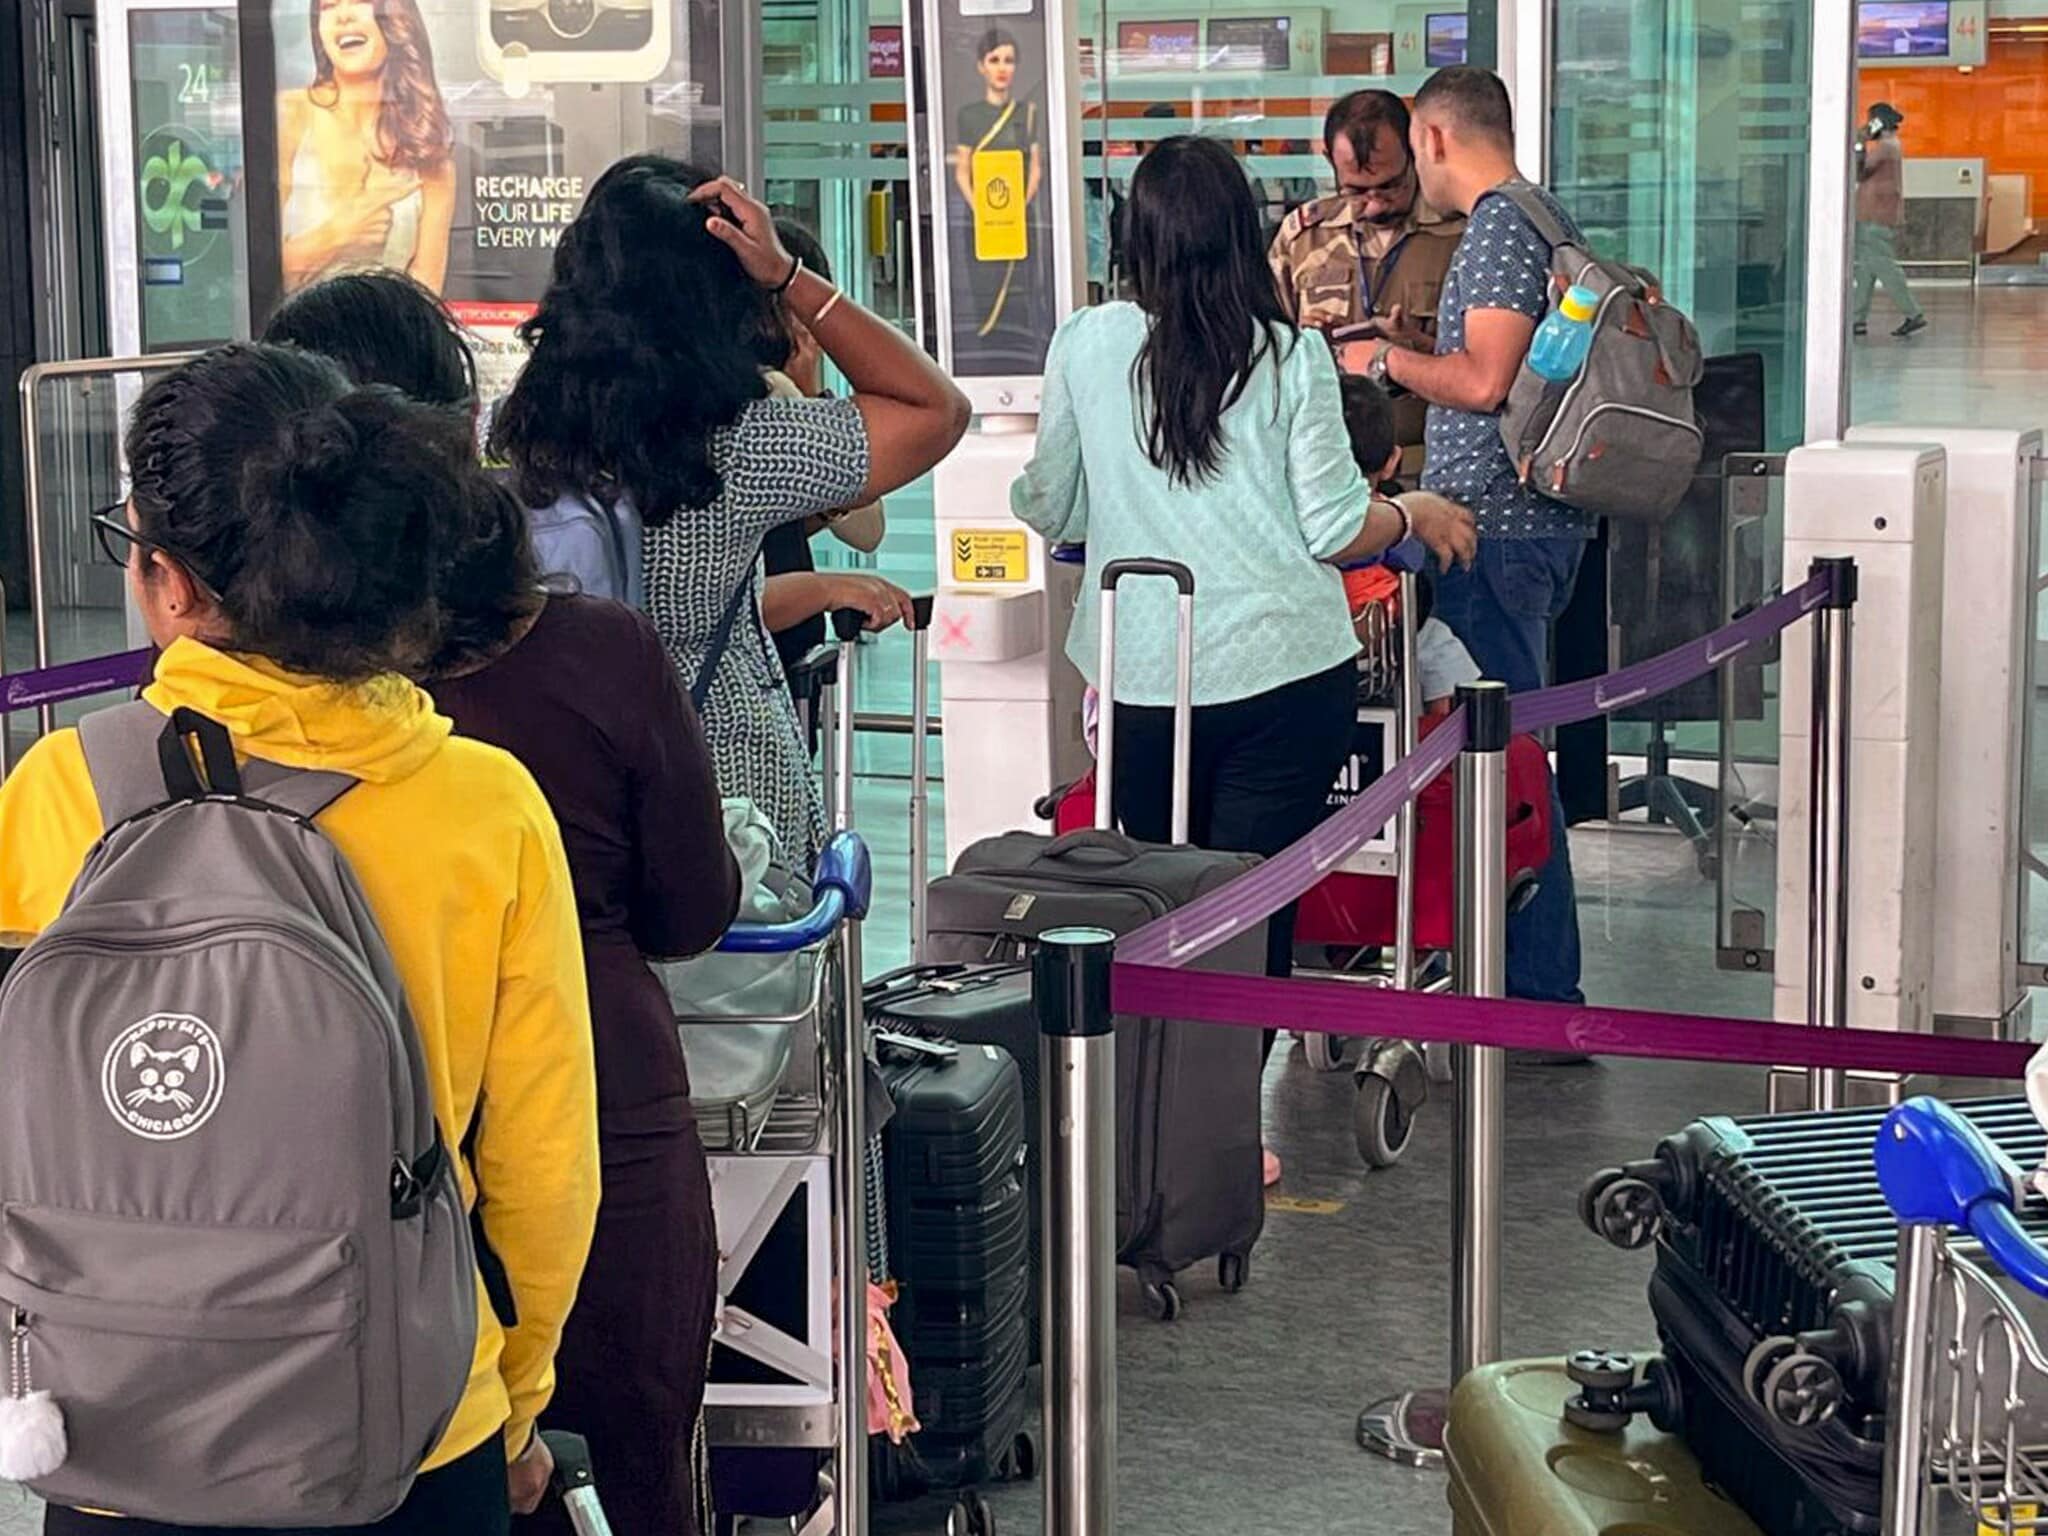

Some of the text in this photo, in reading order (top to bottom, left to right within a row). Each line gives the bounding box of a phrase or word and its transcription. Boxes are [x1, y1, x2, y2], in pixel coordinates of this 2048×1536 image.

[1956, 15, 1977, 40] 44
[178, 63, 209, 103] 24
[475, 176, 583, 198] RECHARGE
[476, 203, 574, 223] YOUR LIFE
[477, 227, 536, 247] EVERY
[129, 1019, 178, 1042] HAPPY
[127, 1110, 194, 1132] CHICAGO
